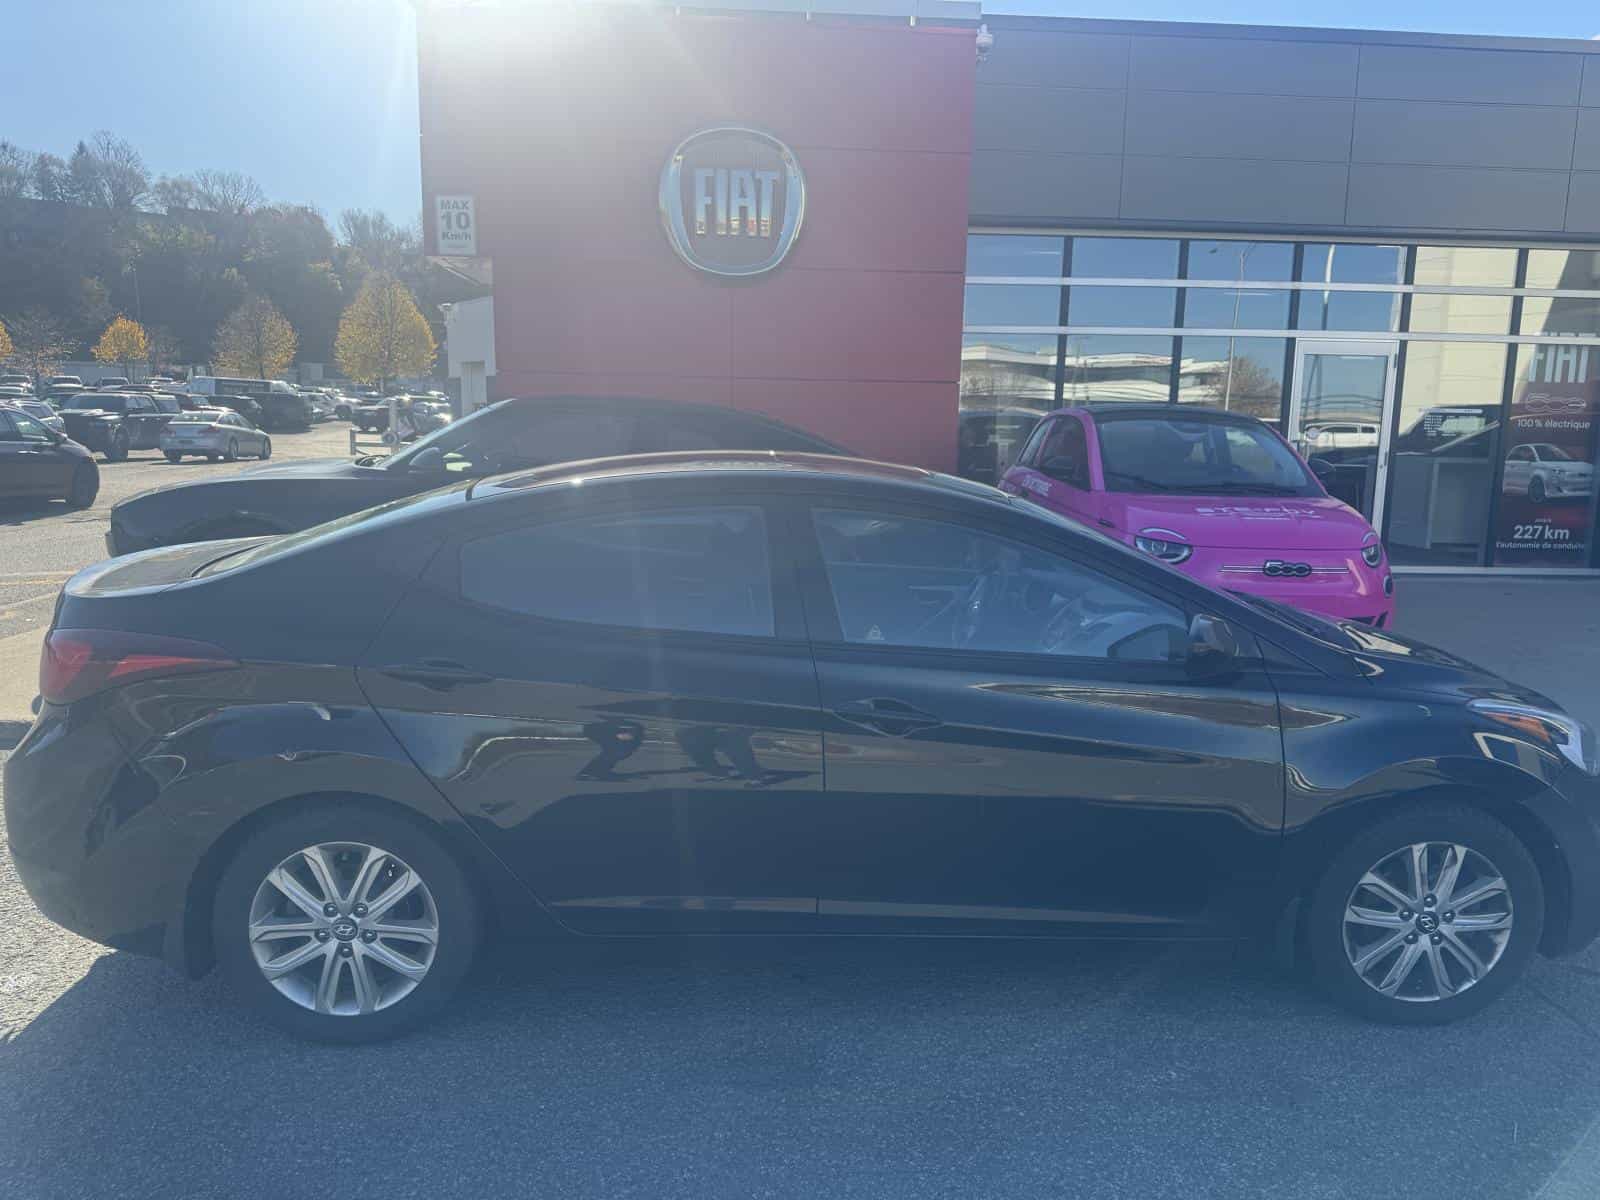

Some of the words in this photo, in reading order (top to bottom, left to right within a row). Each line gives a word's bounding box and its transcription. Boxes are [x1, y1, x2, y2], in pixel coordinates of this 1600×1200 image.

[440, 199, 471, 209] MAX
[695, 168, 780, 237] FIAT
[440, 211, 471, 229] 10
[441, 231, 472, 241] Km/h
[1518, 418, 1534, 428] 100
[1544, 418, 1591, 430] électrique
[1513, 525, 1543, 539] 227
[1544, 525, 1570, 540] km
[1264, 560, 1312, 577] 500
